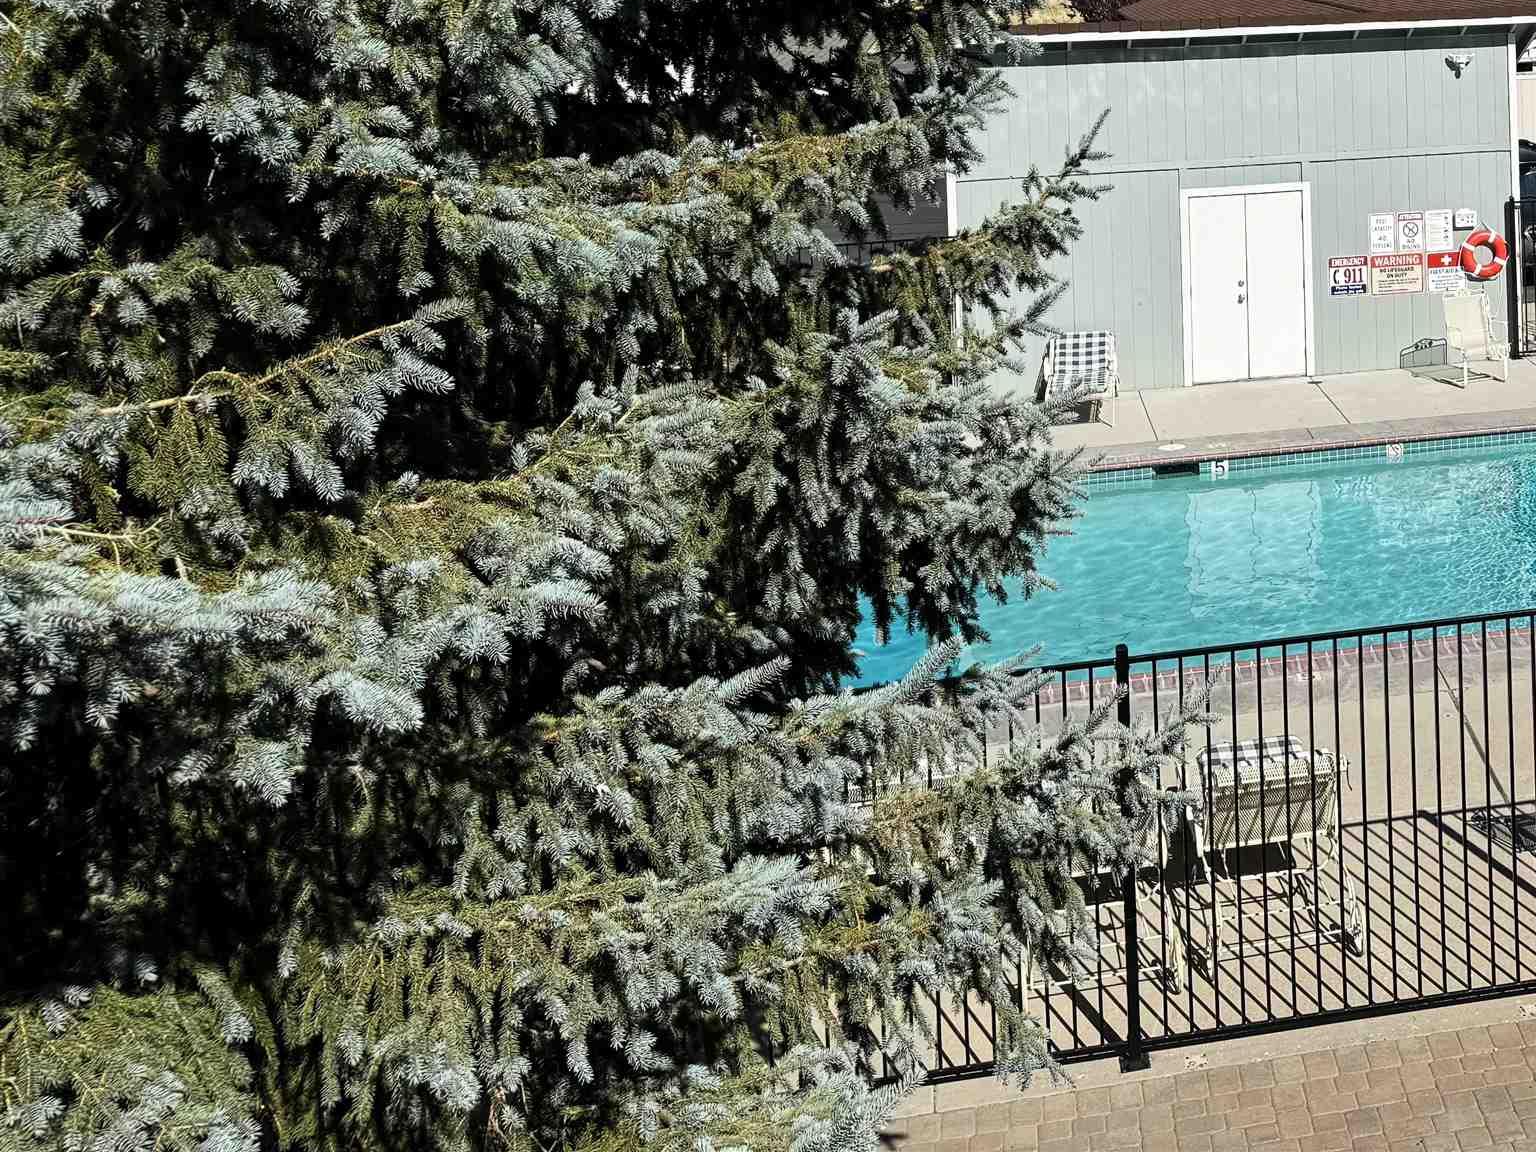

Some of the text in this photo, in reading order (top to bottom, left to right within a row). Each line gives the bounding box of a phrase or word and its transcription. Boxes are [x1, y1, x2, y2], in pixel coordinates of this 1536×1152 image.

[1331, 258, 1365, 266] EMERGENCY
[1374, 254, 1420, 267] WARNING
[1343, 267, 1364, 284] 911
[1215, 460, 1225, 473] 5
